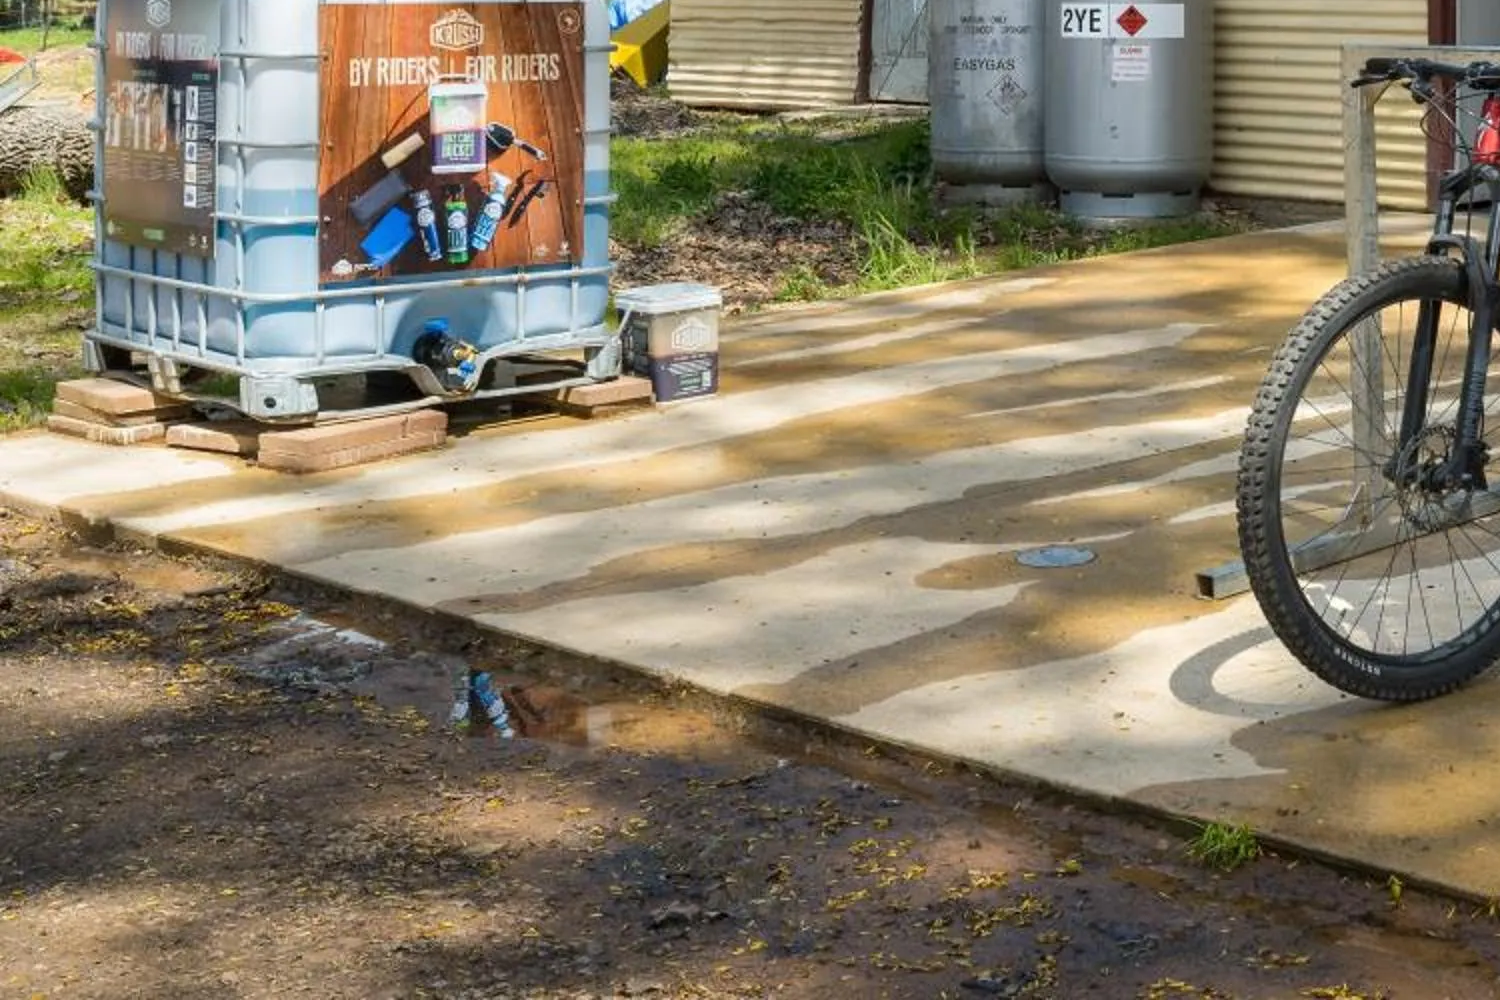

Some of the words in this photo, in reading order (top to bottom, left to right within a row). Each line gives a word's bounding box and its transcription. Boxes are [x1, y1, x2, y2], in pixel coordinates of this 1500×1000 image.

[1063, 9, 1102, 33] 2YE
[350, 56, 373, 87] BY
[377, 55, 440, 87] RIDERS
[465, 55, 497, 83] FOR
[502, 53, 561, 82] RIDERS
